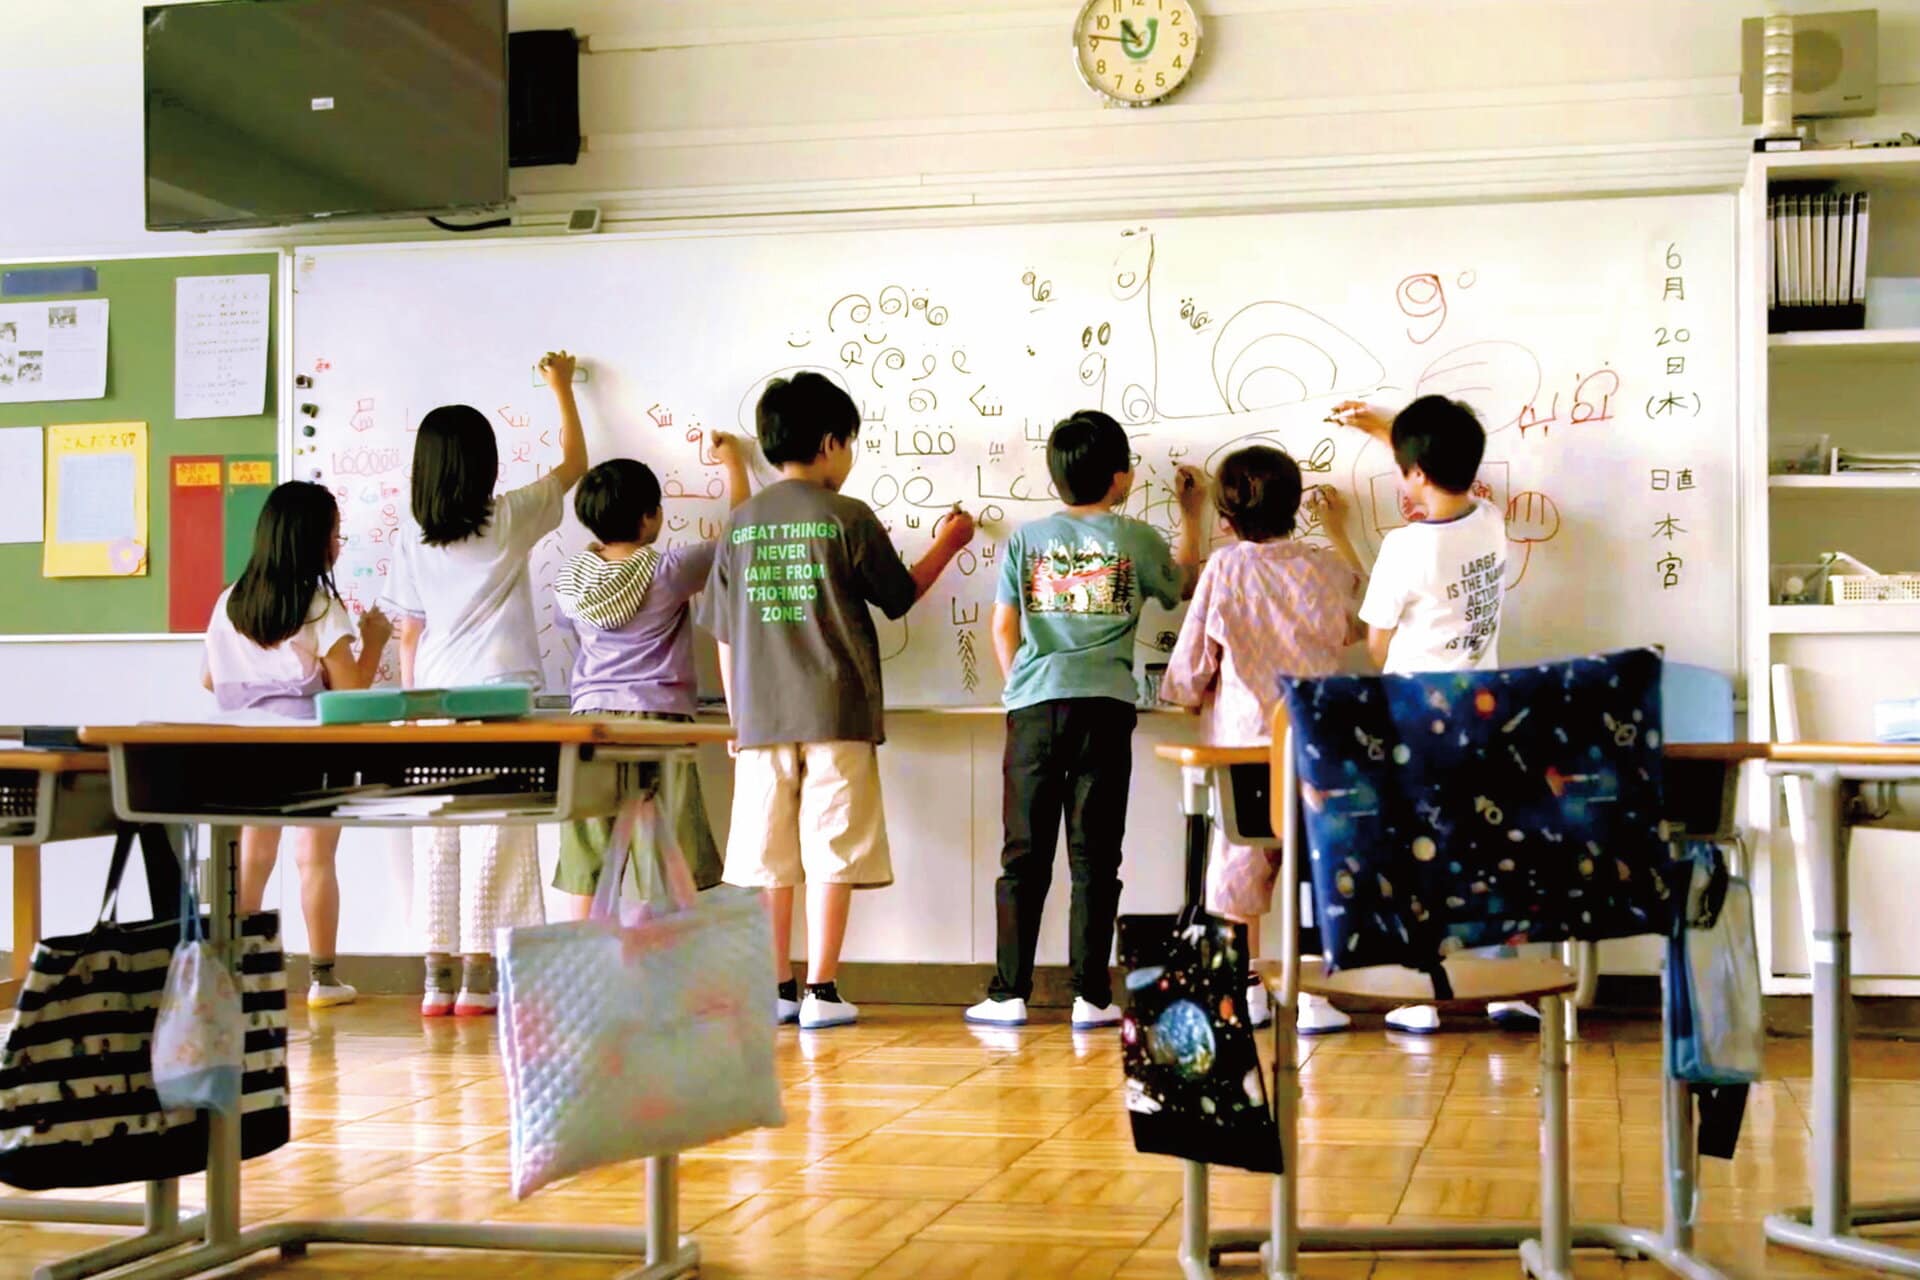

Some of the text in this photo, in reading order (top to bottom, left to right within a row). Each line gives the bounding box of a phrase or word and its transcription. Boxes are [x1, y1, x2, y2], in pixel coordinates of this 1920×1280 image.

[1096, 15, 1110, 30] 10
[1171, 10, 1181, 26] 2
[1088, 38, 1099, 52] 9
[1179, 32, 1189, 47] 3
[1096, 59, 1106, 74] 8
[1172, 55, 1182, 69] 4
[1114, 74, 1123, 89] 7
[1134, 79, 1145, 94] 6
[1155, 72, 1165, 87] 5
[1650, 467, 1697, 491] 日直
[732, 522, 838, 545] GREAT THINGS
[757, 543, 806, 561] NEVER
[786, 563, 825, 580] FROM
[1446, 583, 1460, 600] IS
[1460, 574, 1483, 594] THE
[761, 605, 807, 622] ZONE.
